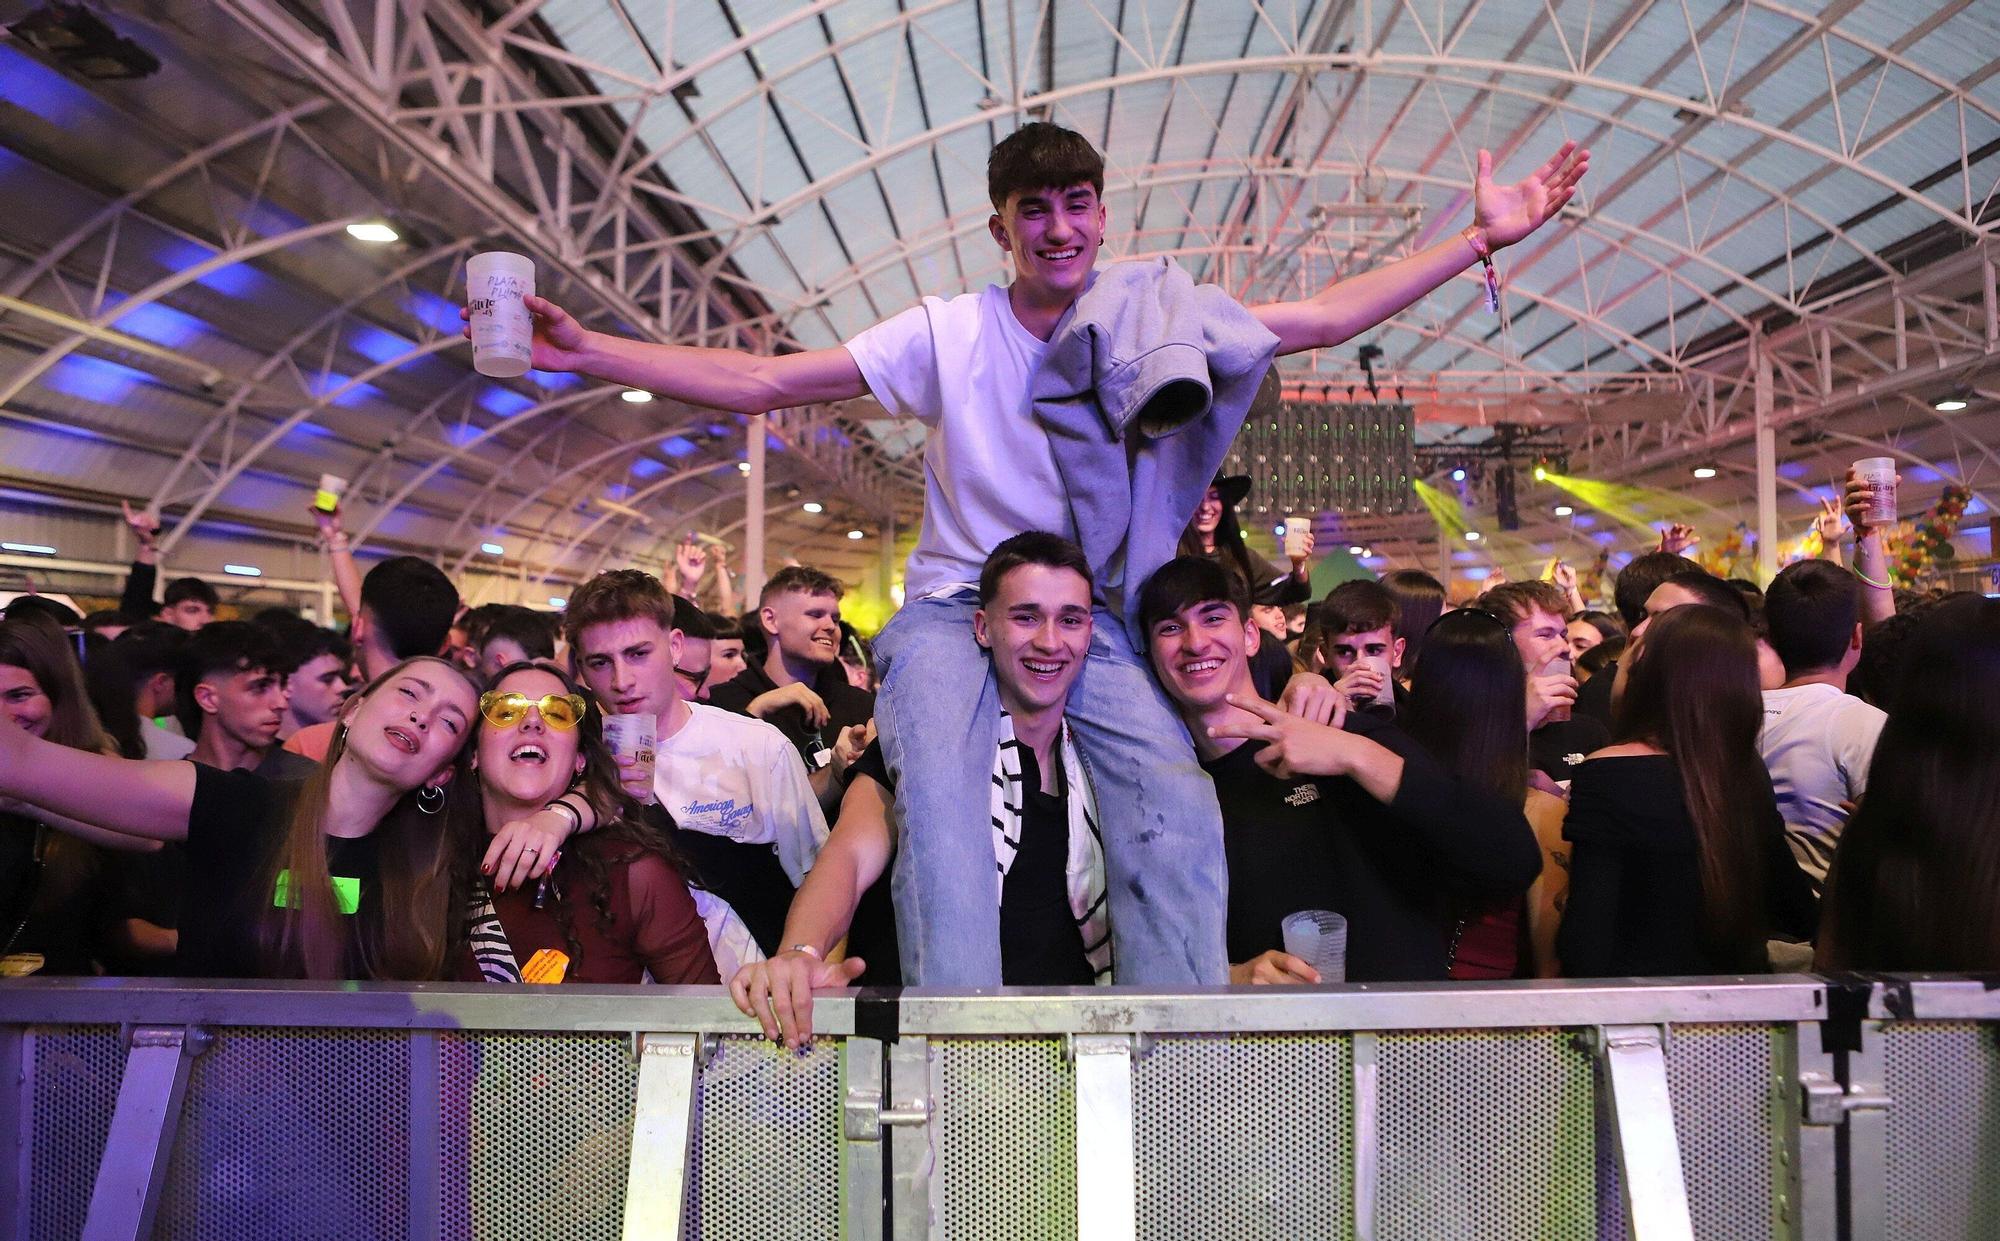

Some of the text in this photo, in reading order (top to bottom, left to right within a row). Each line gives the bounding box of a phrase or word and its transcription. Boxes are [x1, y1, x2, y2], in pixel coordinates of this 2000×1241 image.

[1293, 784, 1309, 794] THE
[1284, 790, 1311, 803] NORTH
[1293, 796, 1312, 807] FACE
[680, 799, 735, 815] American
